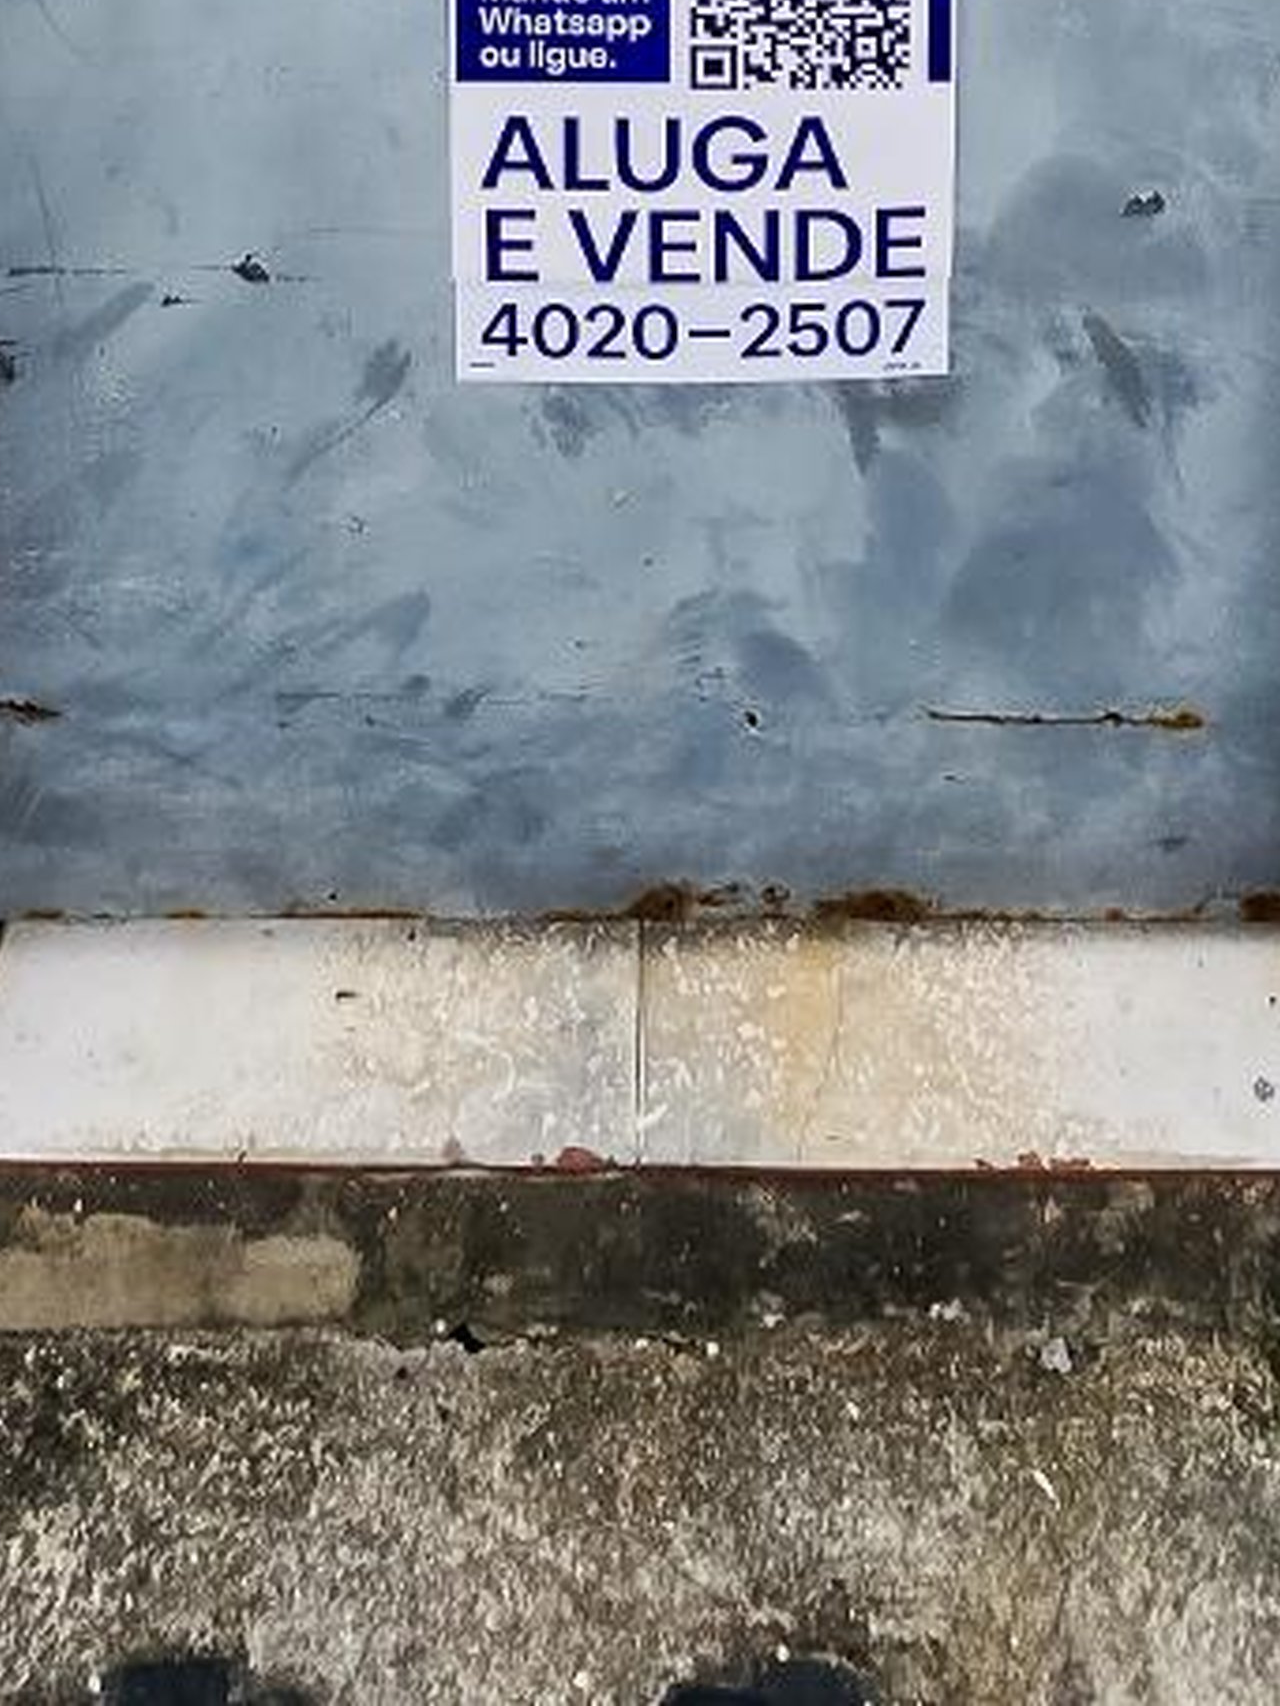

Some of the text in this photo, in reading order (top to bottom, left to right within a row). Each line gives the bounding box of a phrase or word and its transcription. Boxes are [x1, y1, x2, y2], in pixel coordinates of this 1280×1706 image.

[478, 7, 652, 42] Whatsapp
[479, 40, 617, 75] ou ligue.
[480, 116, 849, 193] ALUGA
[485, 207, 926, 283] E VENDE
[481, 299, 927, 361] 4020-2507
